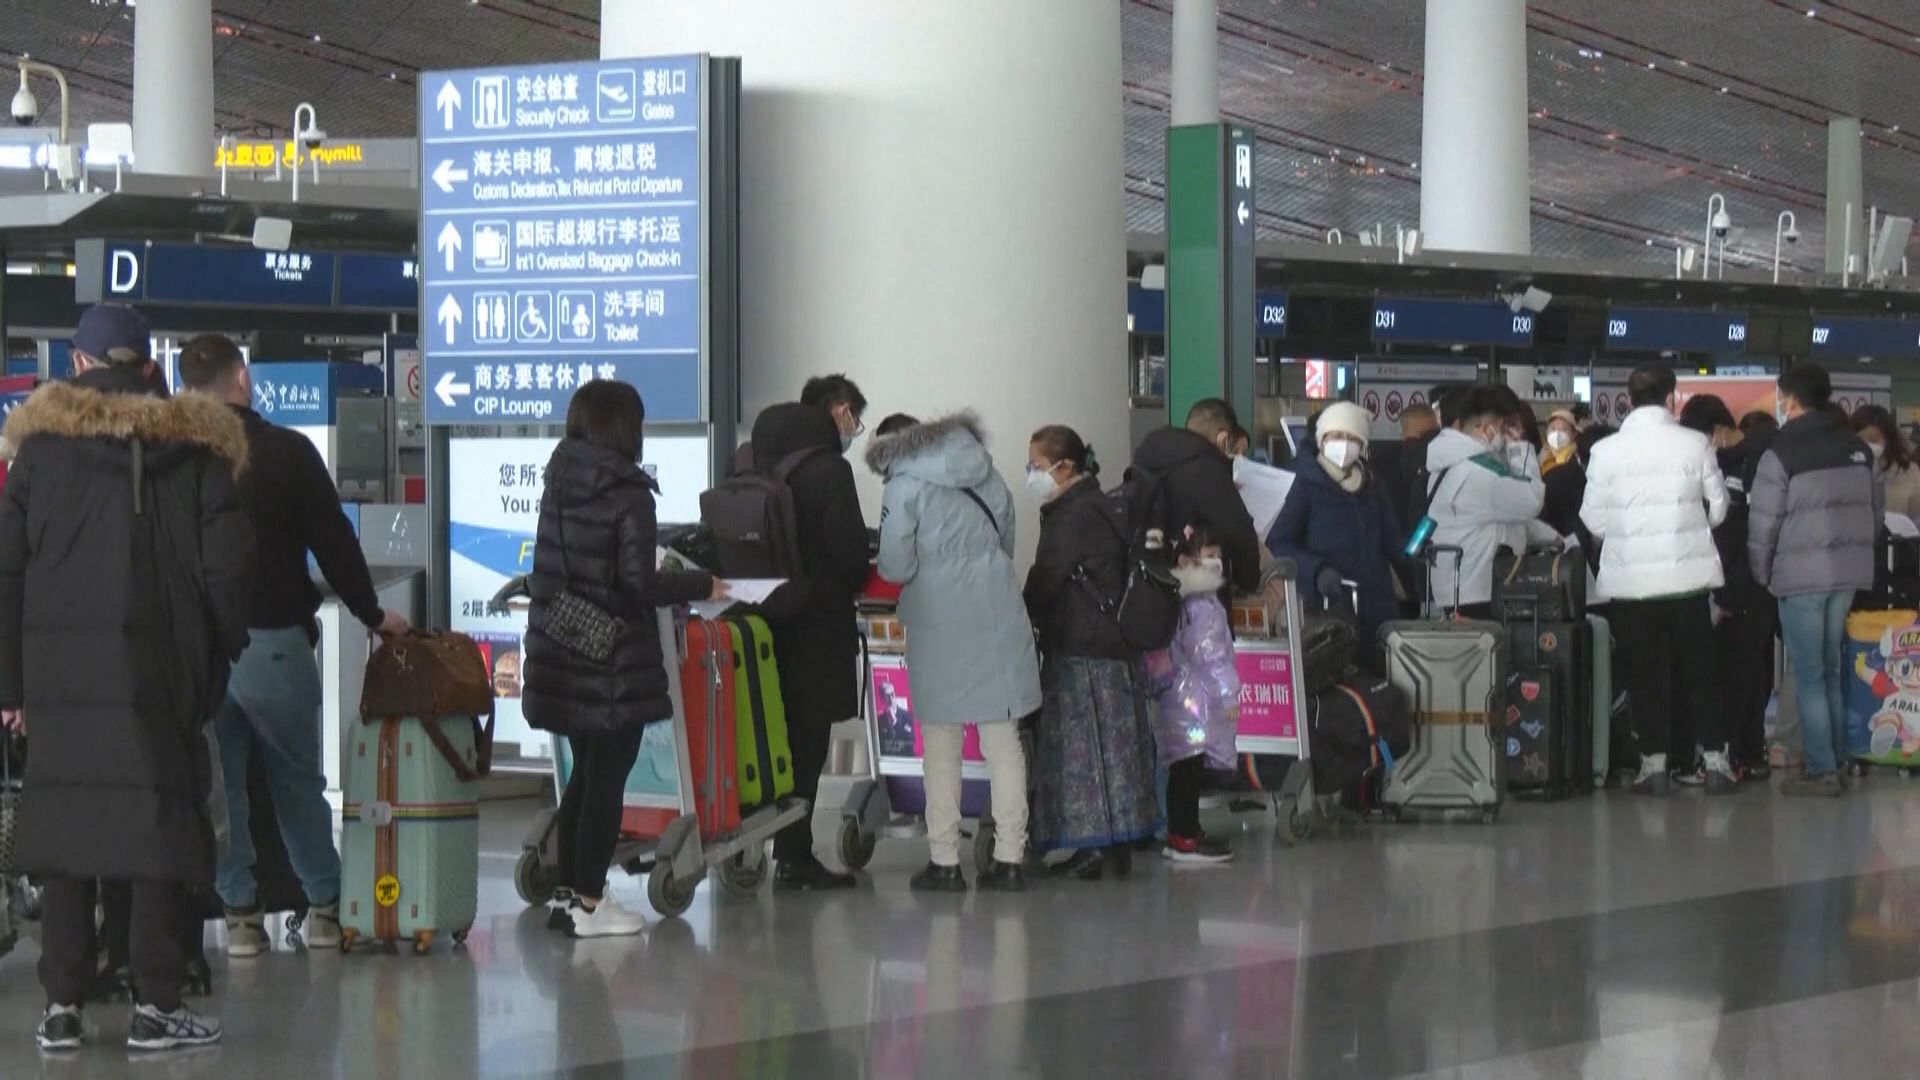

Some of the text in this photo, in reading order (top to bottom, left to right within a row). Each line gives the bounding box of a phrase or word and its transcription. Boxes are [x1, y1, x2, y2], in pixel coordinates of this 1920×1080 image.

[516, 74, 578, 103] 安全检查
[642, 70, 686, 96] 登机口
[516, 105, 590, 128] Security Check
[642, 102, 675, 121] Gates
[473, 143, 657, 176] 海关申报、离境退税
[473, 183, 509, 201] Customs
[573, 178, 603, 196] Refund
[604, 180, 612, 194] at
[613, 176, 630, 194] Port
[631, 177, 641, 191] of
[641, 175, 683, 197] Departure
[515, 216, 681, 248] 国际超规行李托运
[536, 250, 585, 270] Oversized
[588, 250, 633, 272] Baggage
[636, 248, 681, 268] Check-in
[111, 249, 138, 292] D
[274, 269, 302, 281] Tickets
[603, 289, 665, 317] 洗手间
[1263, 306, 1285, 324] D32
[1375, 312, 1396, 329] D31
[1512, 316, 1532, 333] D30
[603, 323, 639, 342] Toilet
[1608, 320, 1627, 337] D29
[1728, 326, 1745, 341] D28
[1812, 328, 1829, 344] D27
[474, 397, 553, 418] CIP Lounge
[501, 494, 530, 513] You
